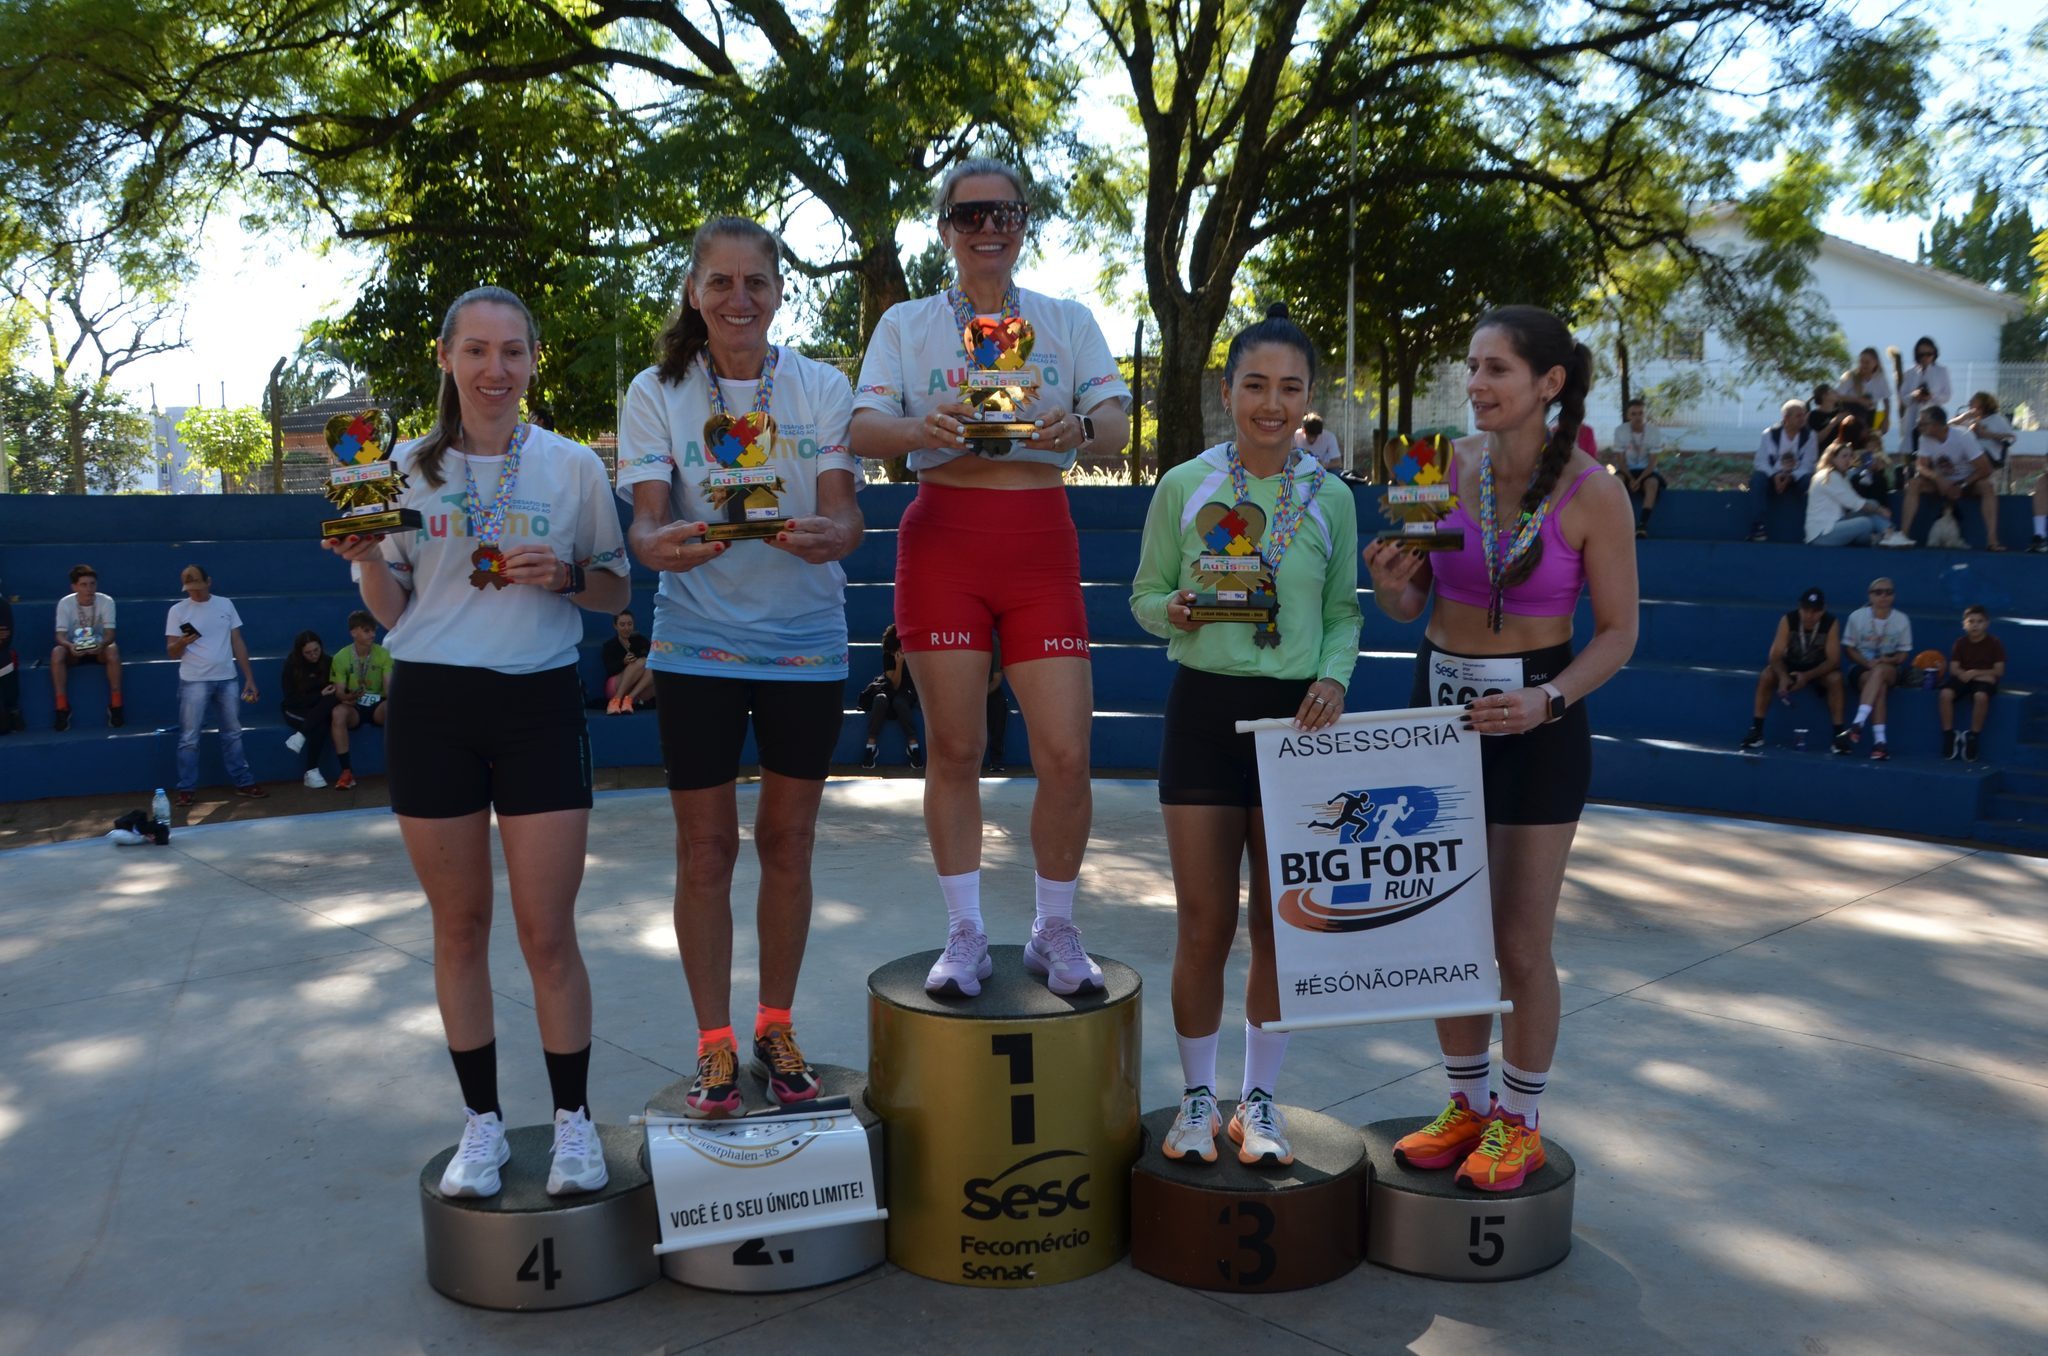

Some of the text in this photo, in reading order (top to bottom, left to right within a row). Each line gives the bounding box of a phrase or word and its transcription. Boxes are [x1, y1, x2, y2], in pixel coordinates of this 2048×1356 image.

[971, 378, 1030, 387] Autismo
[334, 470, 389, 483] Autismo
[713, 475, 774, 485] Autismo
[1202, 561, 1259, 570] Autismo
[930, 632, 971, 646] RUN
[1278, 723, 1460, 758] ASSESSORIA
[1280, 838, 1464, 886] BIG FORT
[1384, 877, 1434, 901] RUN
[1295, 963, 1479, 996] #ÉSÓNÃOPARAR
[991, 1032, 1036, 1145] 1
[670, 1181, 864, 1229] VOCÊ É O SEU ÚNICO LIMITE!
[960, 1168, 1091, 1221] Sesc
[960, 1228, 1091, 1255] Fecomércio
[1218, 1201, 1277, 1286] 3
[1468, 1215, 1506, 1267] 5
[516, 1237, 562, 1290] 4
[961, 1262, 1036, 1281] Senac
